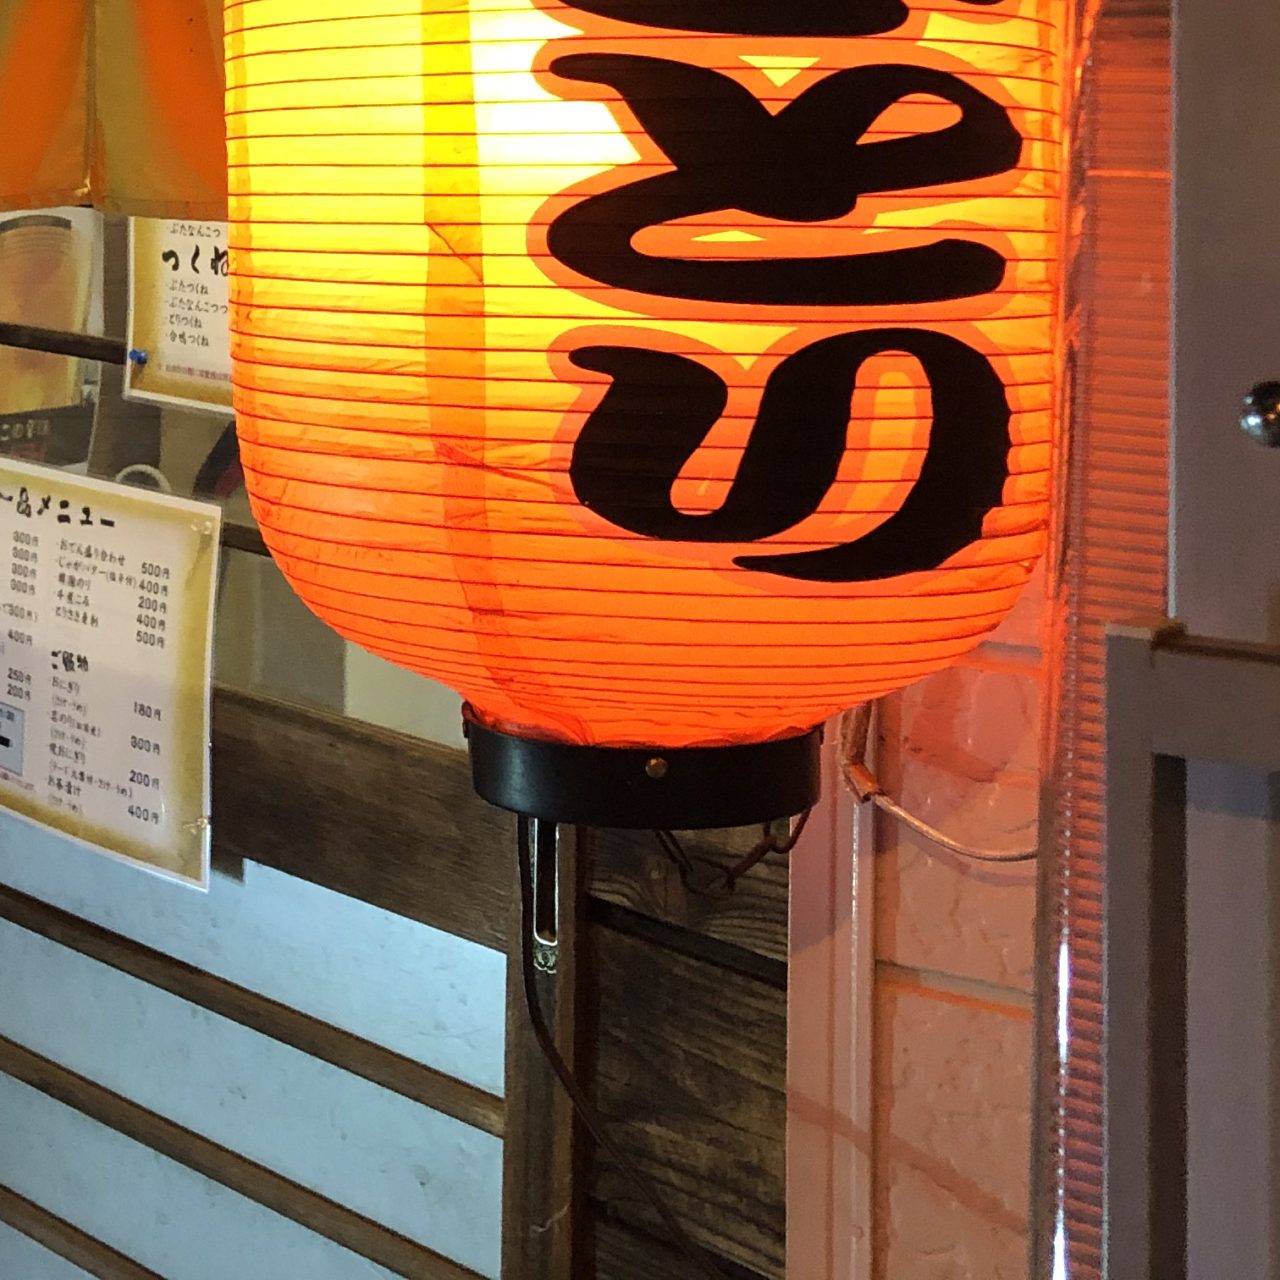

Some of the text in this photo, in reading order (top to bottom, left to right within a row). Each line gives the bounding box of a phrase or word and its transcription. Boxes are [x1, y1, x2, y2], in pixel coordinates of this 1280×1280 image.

[170, 223, 221, 238] ぶたなんこつ
[162, 244, 229, 276] つくね
[169, 281, 208, 295] ぶたつくね
[141, 562, 170, 580] 500円
[139, 579, 169, 597] 400円
[138, 596, 168, 614] 200円
[136, 614, 166, 632] 400円
[136, 631, 165, 649] 500円
[133, 700, 161, 721] 180円
[130, 735, 161, 756] 300円
[129, 769, 160, 790] 200円
[127, 805, 159, 824] 400円
